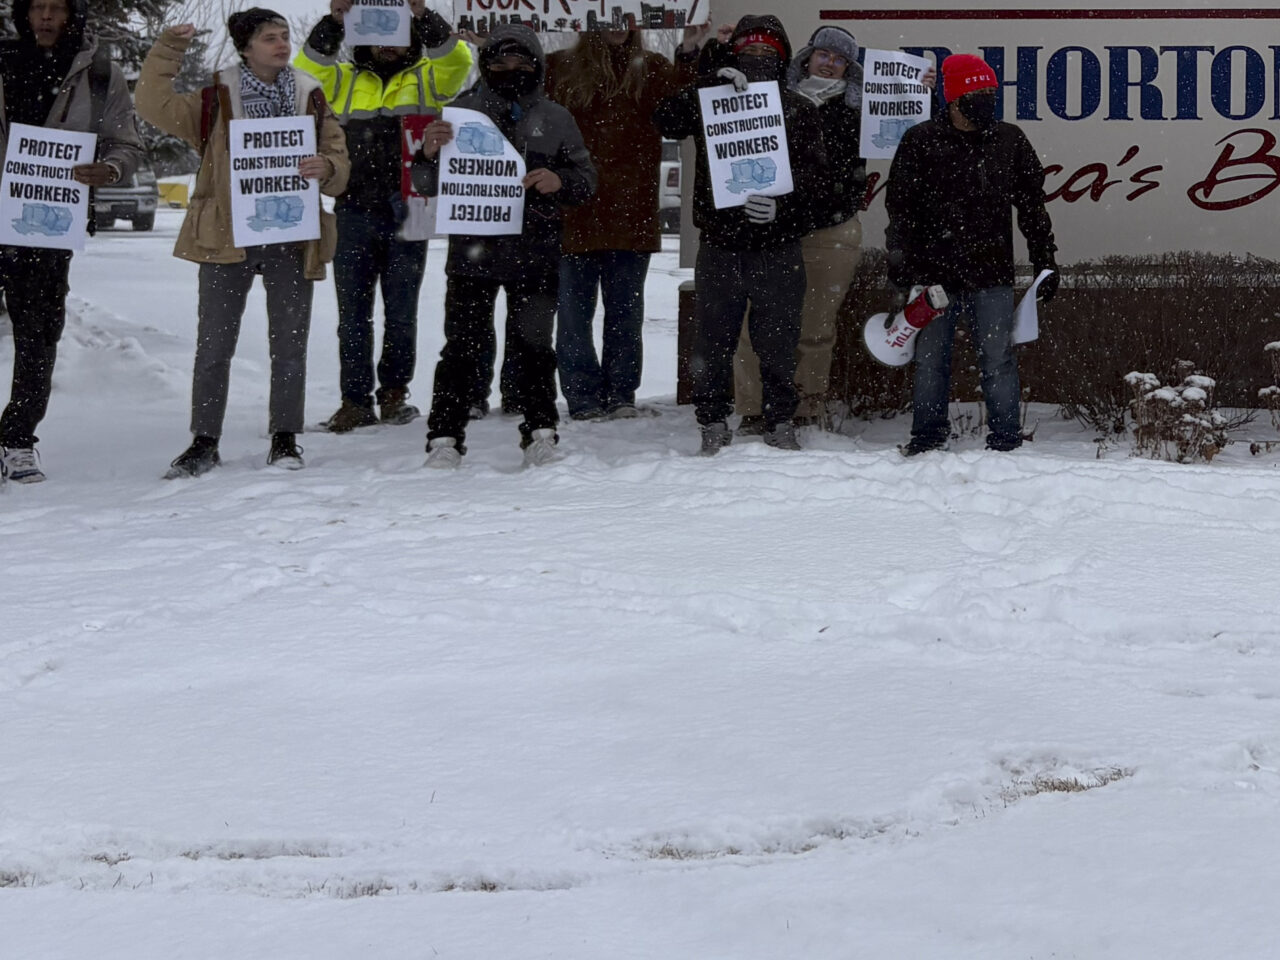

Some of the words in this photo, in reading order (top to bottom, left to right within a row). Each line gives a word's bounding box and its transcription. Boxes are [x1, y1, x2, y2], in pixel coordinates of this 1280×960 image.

[874, 61, 922, 80] PROTECT
[965, 74, 991, 84] CTUL
[865, 82, 929, 95] CONSTRUCTION
[712, 93, 769, 115] PROTECT
[869, 100, 923, 116] WORKERS
[706, 114, 782, 137] CONSTRUCTION
[243, 130, 304, 149] PROTECT
[715, 135, 779, 159] WORKERS
[19, 138, 82, 161] PROTECT
[6, 160, 73, 180] CONSTRUCTI
[449, 158, 518, 177] WORKERS
[10, 182, 80, 204] WORKERS
[240, 175, 310, 194] WORKERS
[442, 182, 523, 198] CONSTRUCTION
[450, 204, 512, 222] PROTECT
